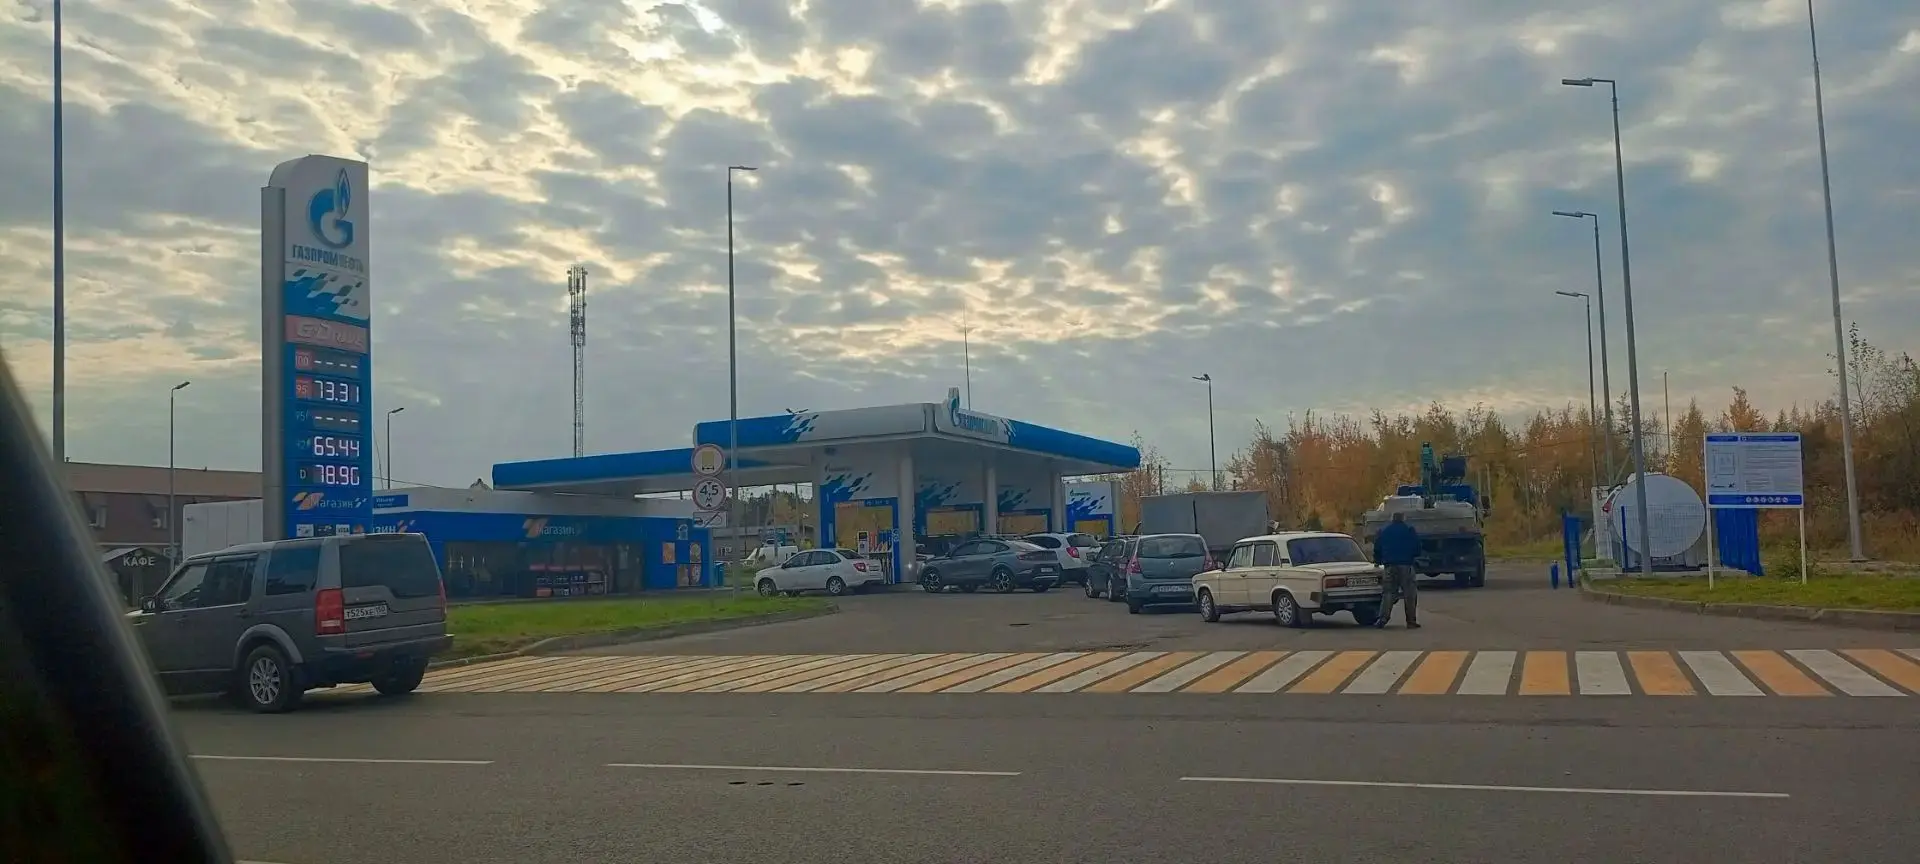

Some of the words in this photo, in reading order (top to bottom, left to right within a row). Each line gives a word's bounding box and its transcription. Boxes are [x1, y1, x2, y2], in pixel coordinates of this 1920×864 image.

[314, 380, 360, 402] 73.31
[314, 436, 360, 457] 65.44
[700, 484, 719, 497] 4,5
[372, 525, 396, 534] зин
[123, 556, 155, 567] КАФЕ
